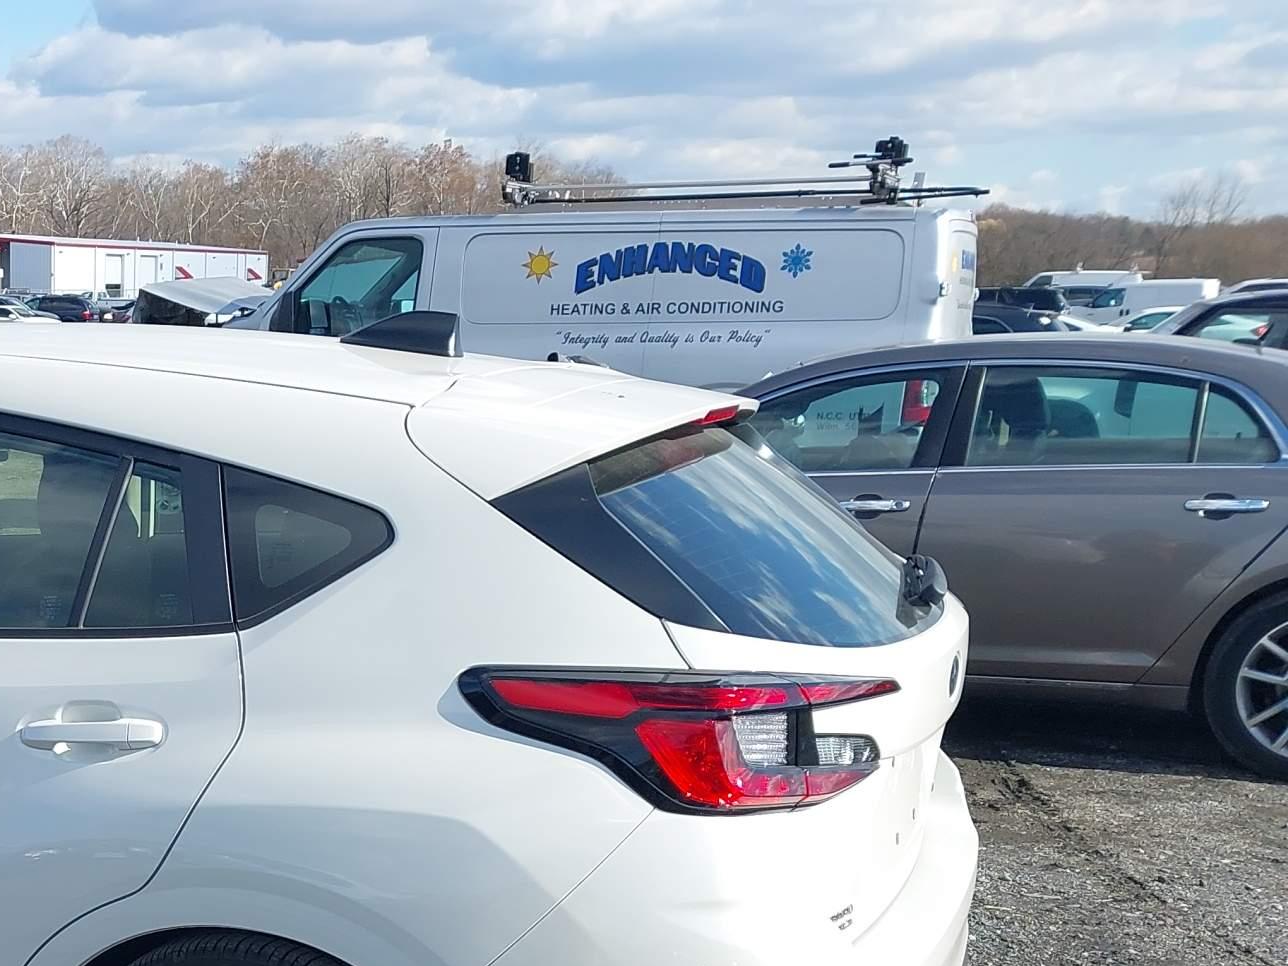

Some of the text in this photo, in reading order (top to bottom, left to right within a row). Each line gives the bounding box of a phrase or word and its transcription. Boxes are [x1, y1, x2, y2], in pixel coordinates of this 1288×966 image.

[574, 241, 767, 296] ENHANCED
[550, 300, 785, 316] HEATING & AIR CONDITIONING
[615, 332, 637, 344] and
[639, 330, 680, 349] Quality
[684, 333, 694, 344] is
[699, 330, 723, 344] Our
